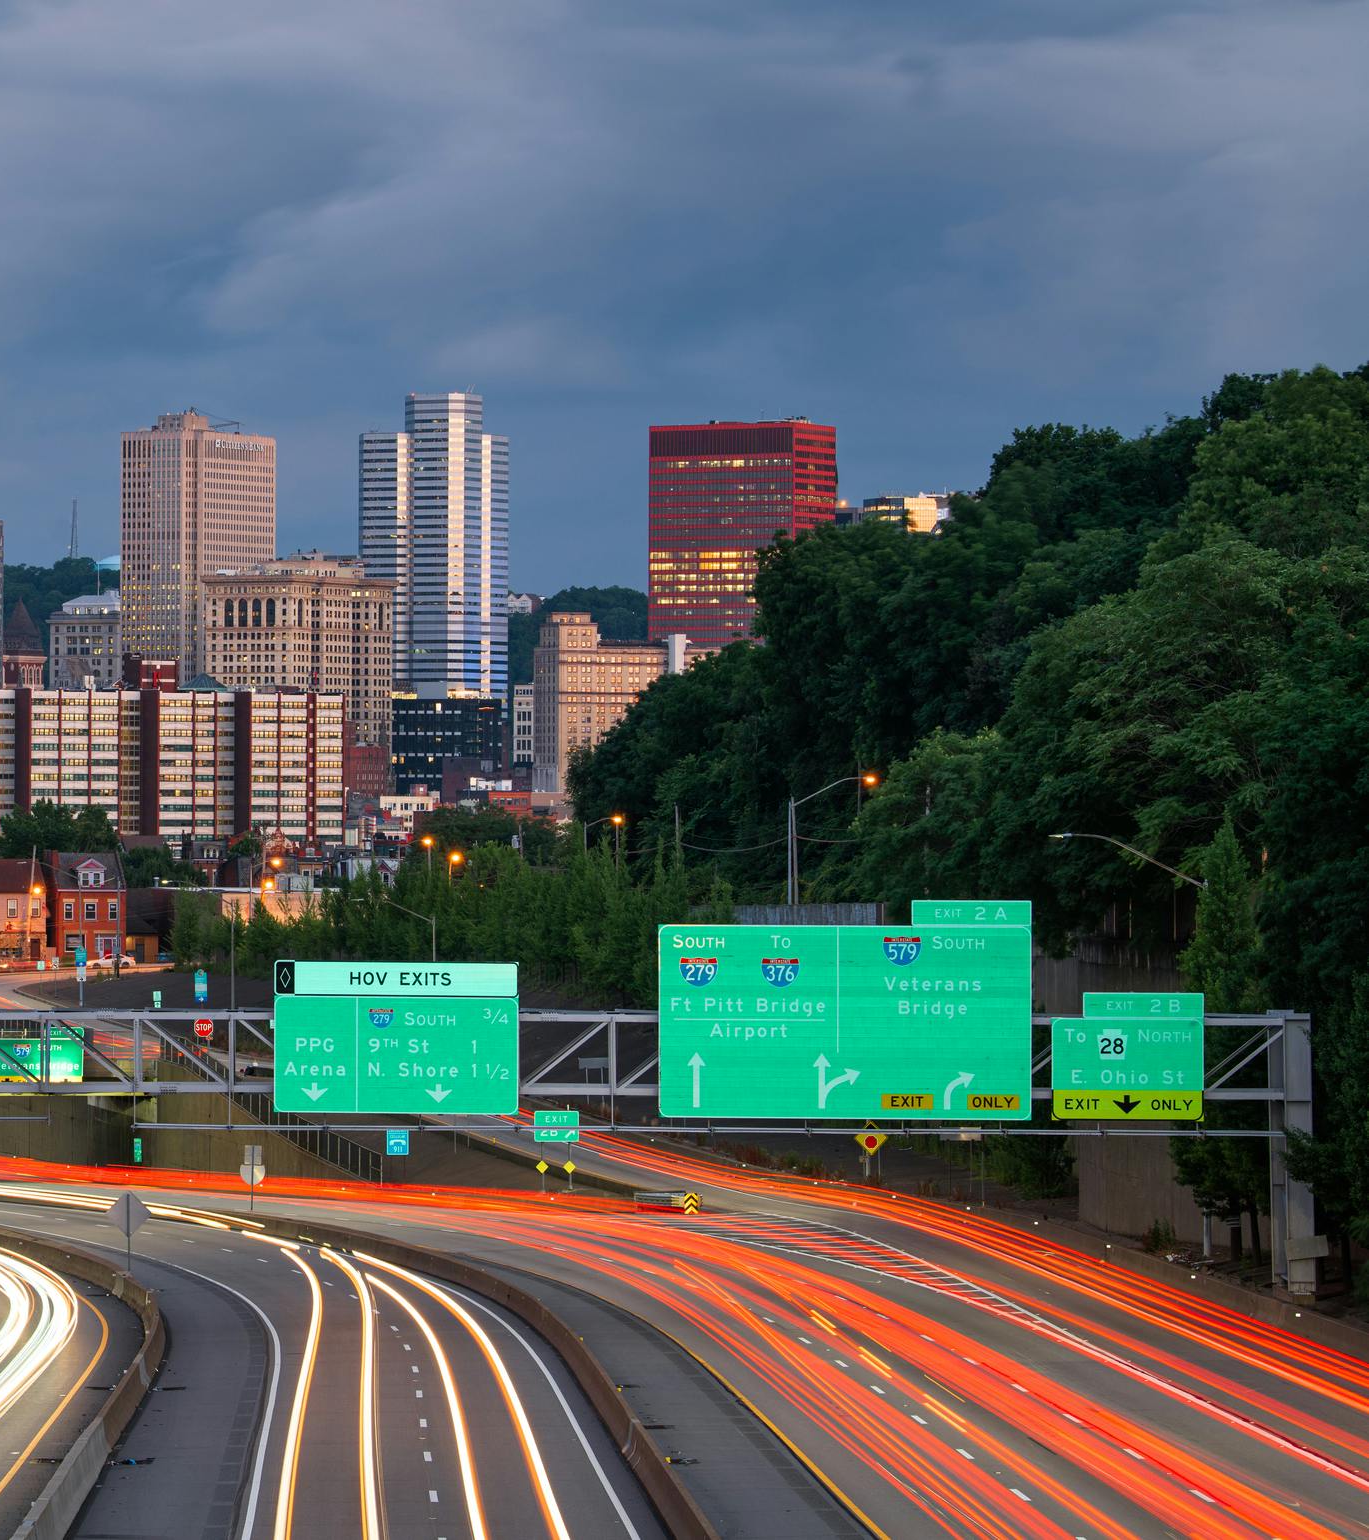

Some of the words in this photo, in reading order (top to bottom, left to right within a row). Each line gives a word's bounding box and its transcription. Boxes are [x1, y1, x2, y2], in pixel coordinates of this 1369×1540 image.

[934, 908, 961, 918] EXIT
[672, 935, 725, 949] SOUTH
[771, 935, 791, 949] To
[932, 936, 985, 950] SOUTH
[888, 943, 917, 960] 579
[349, 971, 387, 986] HOV
[399, 972, 452, 986] EXITS
[685, 964, 715, 981] 279
[766, 965, 795, 982] 376
[884, 976, 982, 992] Veterans
[670, 998, 691, 1013] Ft
[704, 998, 744, 1013] Pitt
[757, 998, 826, 1018] Bridge
[898, 1000, 968, 1019] Bridge
[1106, 1001, 1134, 1010] EXIT
[373, 1013, 390, 1024] 279
[404, 1012, 456, 1026] SOUTH
[195, 1023, 211, 1031] STOP
[710, 1023, 788, 1040] Airport
[1064, 1028, 1087, 1043] To
[1138, 1029, 1192, 1043] NORTH
[16, 1047, 30, 1056] 579
[295, 1038, 334, 1053] PPG
[368, 1038, 399, 1053] 9TH
[408, 1039, 429, 1053] St
[472, 1039, 477, 1054] 1
[1100, 1038, 1124, 1054] 28
[284, 1061, 346, 1076] Arena
[368, 1062, 386, 1077] N.
[398, 1062, 459, 1078] Shore
[1071, 1069, 1087, 1084] E.
[1101, 1069, 1149, 1085] Ohio
[1162, 1070, 1184, 1085] St
[890, 1094, 924, 1108] EXIT
[972, 1095, 1015, 1109] ONLY
[1064, 1098, 1100, 1110] EXIT
[1151, 1099, 1193, 1111] ONLY
[544, 1115, 568, 1123] EXIT
[393, 1145, 403, 1153] 911
